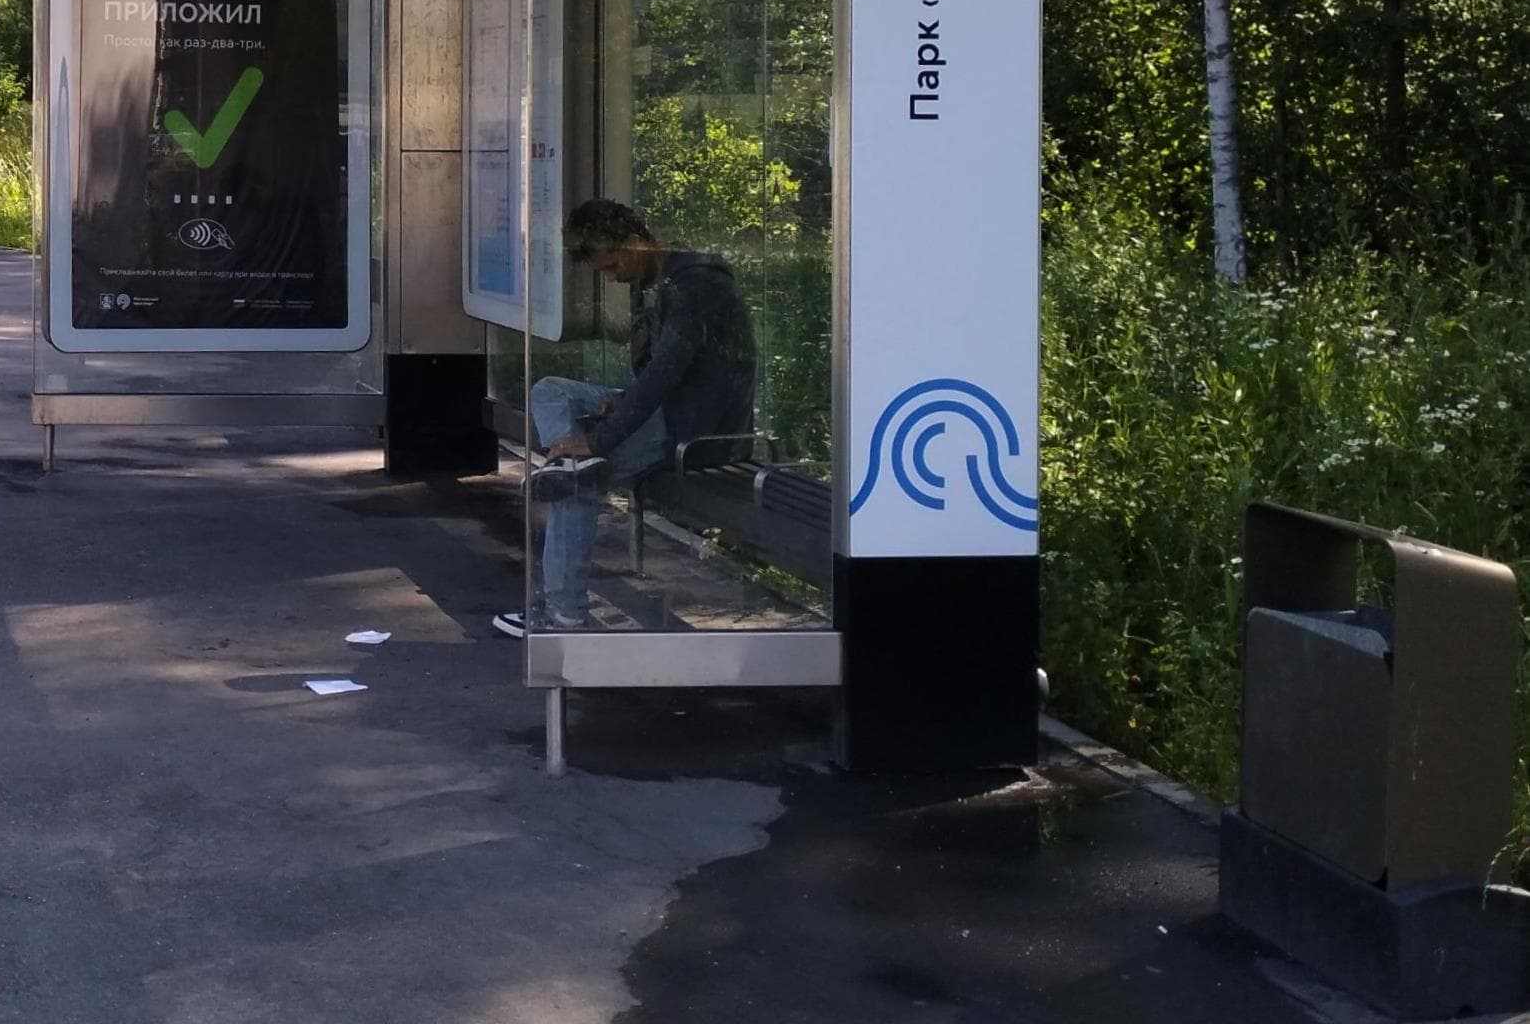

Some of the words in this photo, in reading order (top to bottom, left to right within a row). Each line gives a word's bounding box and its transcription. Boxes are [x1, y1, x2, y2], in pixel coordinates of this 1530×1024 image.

[104, 0, 262, 25] ПРИЛОЖИЛ
[159, 38, 181, 49] как
[909, 19, 947, 121] Парк
